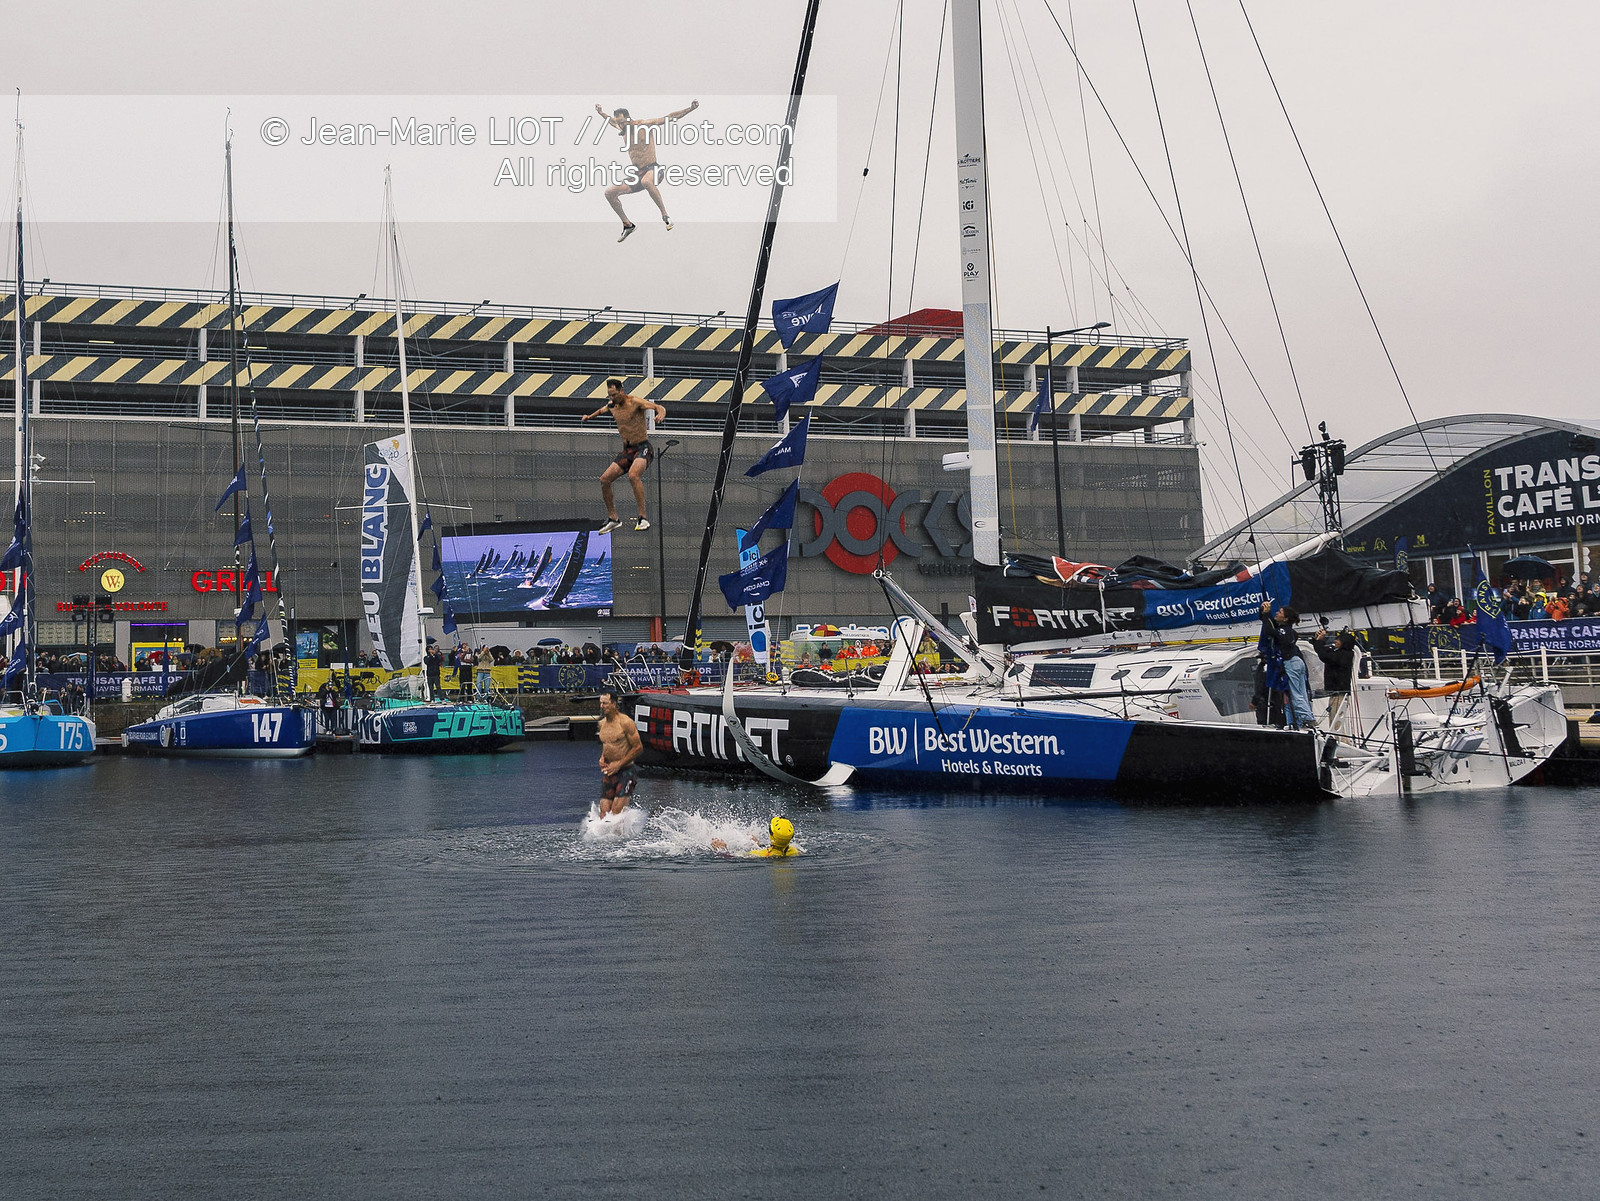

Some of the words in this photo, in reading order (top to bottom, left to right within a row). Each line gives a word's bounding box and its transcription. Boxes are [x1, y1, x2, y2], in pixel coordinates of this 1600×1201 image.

[1483, 469, 1496, 535] PAVILLON
[1497, 485, 1574, 518] CAFÉ
[361, 464, 391, 584] BLANC
[1500, 522, 1515, 533] LE
[1520, 517, 1562, 531] HAVRE
[79, 551, 146, 573] RESTAURANT
[114, 602, 168, 611] VOLONTE
[1157, 603, 1186, 617] BW
[1194, 598, 1220, 611] Best
[1206, 612, 1230, 620] Hotels
[1237, 606, 1260, 615] Resort
[58, 722, 83, 750] 175
[252, 712, 283, 743] 147
[432, 711, 494, 738] 205
[869, 726, 908, 755] BW
[924, 727, 968, 753] Best
[968, 728, 1060, 756] Western
[941, 758, 980, 774] Hotels
[982, 760, 993, 775] &
[994, 761, 1043, 777] Resorts
